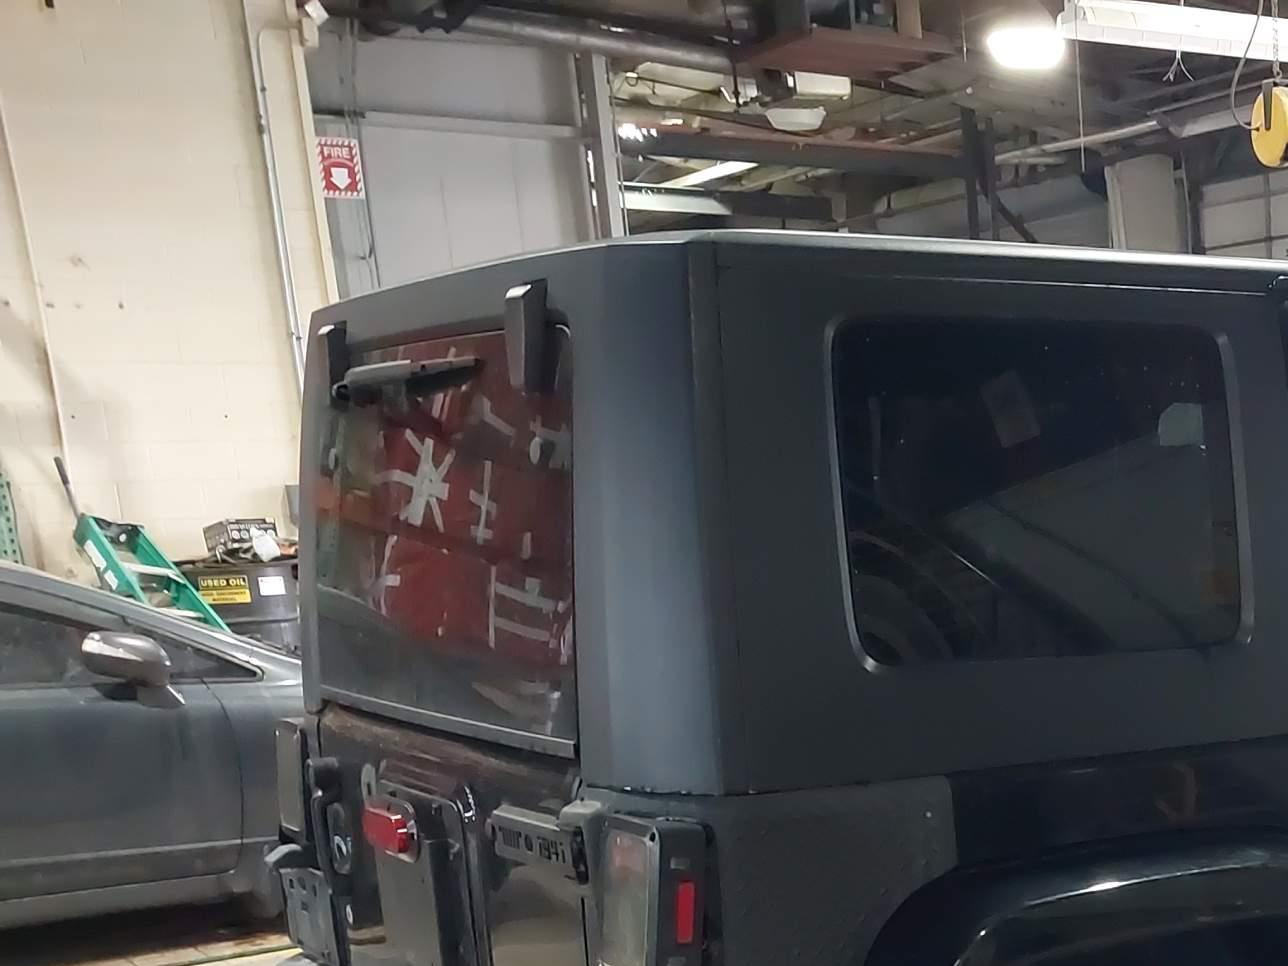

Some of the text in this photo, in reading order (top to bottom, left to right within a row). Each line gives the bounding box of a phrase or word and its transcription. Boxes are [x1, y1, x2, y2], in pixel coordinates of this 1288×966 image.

[323, 146, 351, 159] FIRE
[200, 577, 246, 587] USED OIL
